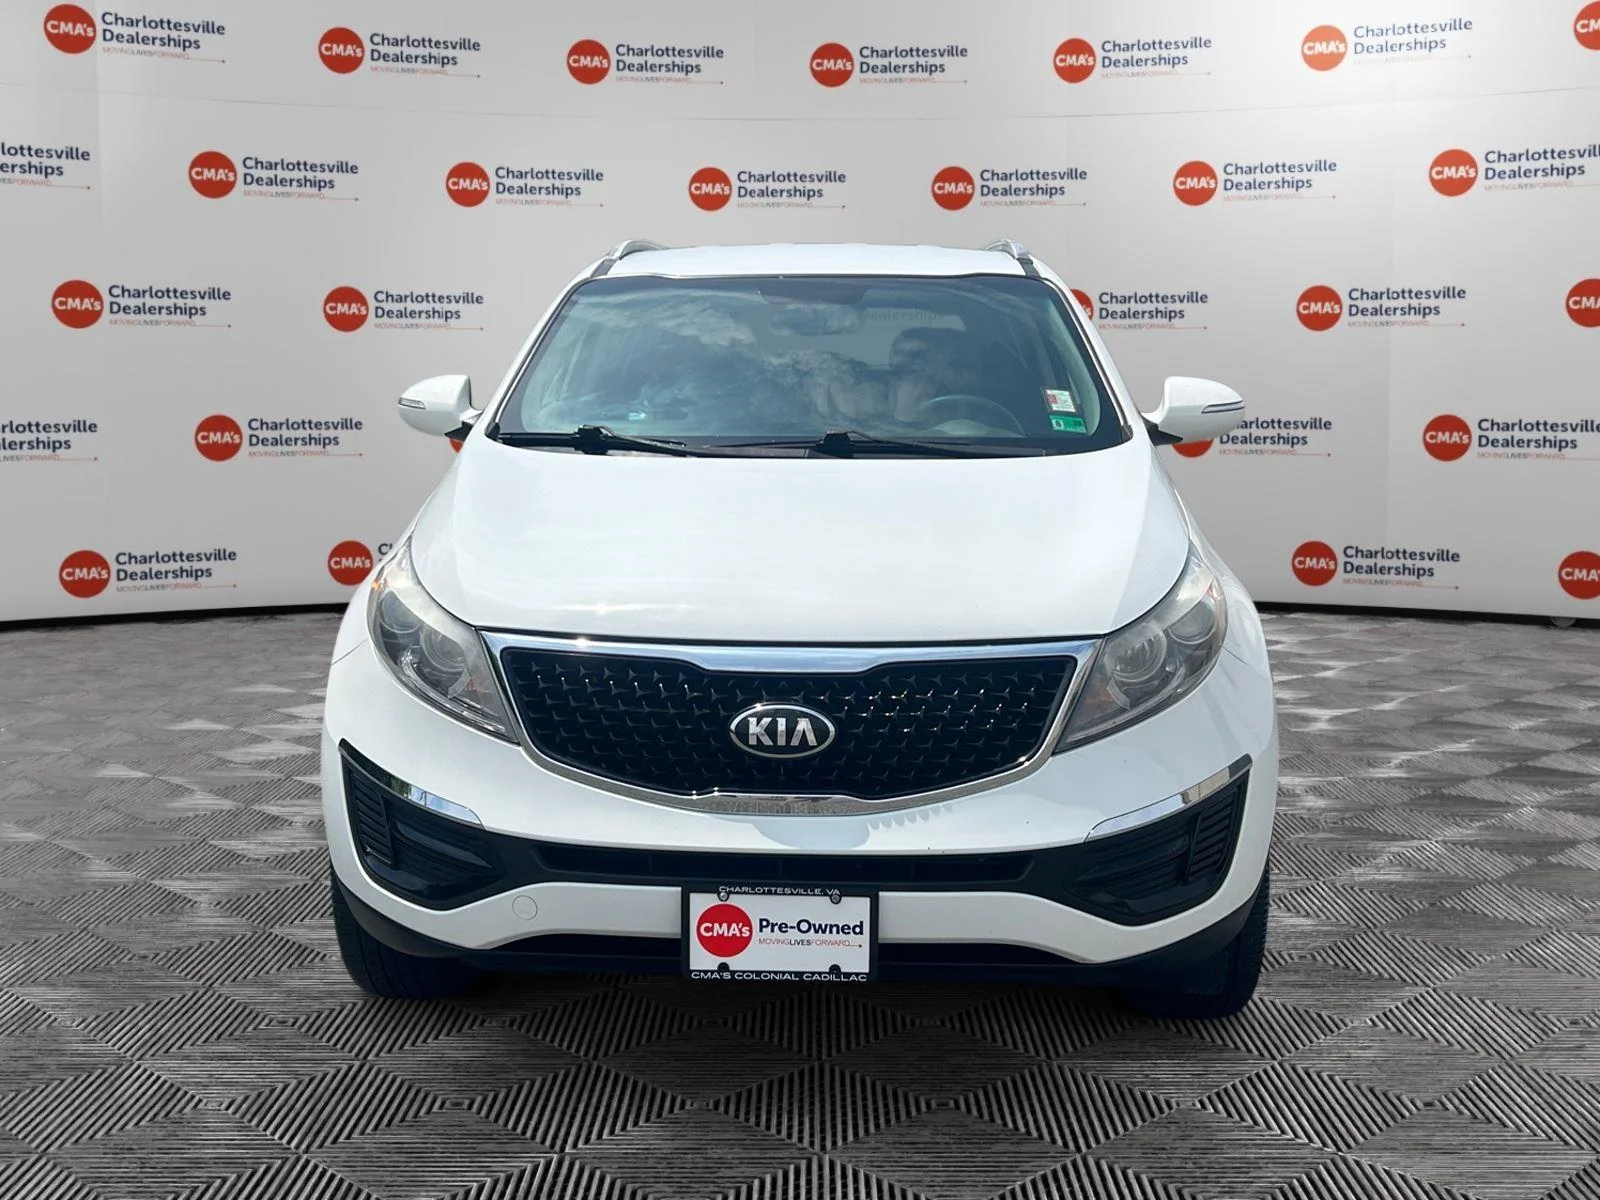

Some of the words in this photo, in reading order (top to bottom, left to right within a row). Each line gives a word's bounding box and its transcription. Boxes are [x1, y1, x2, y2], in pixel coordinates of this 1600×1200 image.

[46, 21, 94, 36] CMA's
[101, 12, 225, 35] Charlottesville
[1354, 18, 1472, 38] Charlottesville
[102, 29, 201, 50] Dealerships
[370, 33, 480, 51] Charlottesville
[1101, 36, 1211, 53] Charlottesville
[1355, 38, 1446, 55] Dealerships
[321, 44, 362, 57] CMA's
[616, 44, 724, 58] Charlottesville
[859, 45, 968, 59] Charlottesville
[1304, 41, 1346, 55] CMA's
[370, 49, 458, 67] Dealerships
[568, 56, 608, 67] CMA's
[812, 59, 852, 70] CMA's
[1056, 55, 1095, 66] CMA's
[1102, 54, 1188, 69] Dealerships
[616, 59, 701, 75] Dealerships
[860, 61, 945, 75] Dealerships
[242, 157, 358, 174] Charlottesville
[1223, 160, 1336, 175] Charlottesville
[1431, 166, 1476, 179] CMA's
[1485, 163, 1585, 180] Dealerships
[191, 168, 235, 181] CMA's
[495, 166, 603, 181] Charlottesville
[737, 170, 846, 183] Charlottesville
[980, 168, 1087, 182] Charlottesville
[243, 172, 335, 191] Dealerships
[448, 178, 488, 190] CMA's
[691, 183, 730, 194] CMA's
[934, 183, 973, 194] CMA's
[1175, 177, 1216, 189] CMA's
[1223, 177, 1312, 191] Dealerships
[496, 181, 581, 198] Dealerships
[737, 185, 823, 201] Dealerships
[980, 184, 1065, 199] Dealerships
[108, 284, 231, 302] Charlottesville
[373, 290, 483, 304] Charlottesville
[1099, 291, 1209, 305] Charlottesville
[1348, 286, 1466, 301] Charlottesville
[54, 297, 102, 310] CMA's
[109, 301, 207, 318] Dealerships
[325, 303, 368, 314] CMA's
[1299, 302, 1341, 313] CMA's
[1348, 302, 1440, 318] Dealerships
[375, 306, 461, 321] Dealerships
[1099, 307, 1185, 322] Dealerships
[248, 417, 363, 431] Charlottesville
[1237, 417, 1332, 430] arlottesville
[0, 436, 72, 452] lerships
[197, 432, 240, 443] CMA's
[249, 433, 339, 448] Dealerships
[1220, 433, 1308, 449] Dealerships
[1425, 432, 1469, 443] CMA's
[1478, 434, 1577, 451] Dealerships
[115, 548, 236, 565] Charlottesville
[1343, 546, 1460, 563] Charlottesville
[330, 557, 371, 569] CMA's
[1294, 557, 1335, 569] CMA's
[1343, 561, 1434, 579] Dealerships
[62, 568, 108, 580] CMA's
[116, 565, 212, 584] Dealerships
[748, 717, 818, 746] KIA
[719, 885, 824, 896] CHARLOTTESVILLE,
[827, 888, 841, 896] VA
[700, 922, 750, 938] CMA's
[758, 918, 864, 936] Pre-Owned
[691, 971, 732, 981] CMA'S
[734, 972, 799, 981] COLONIAL
[803, 973, 867, 982] CADILLAC
